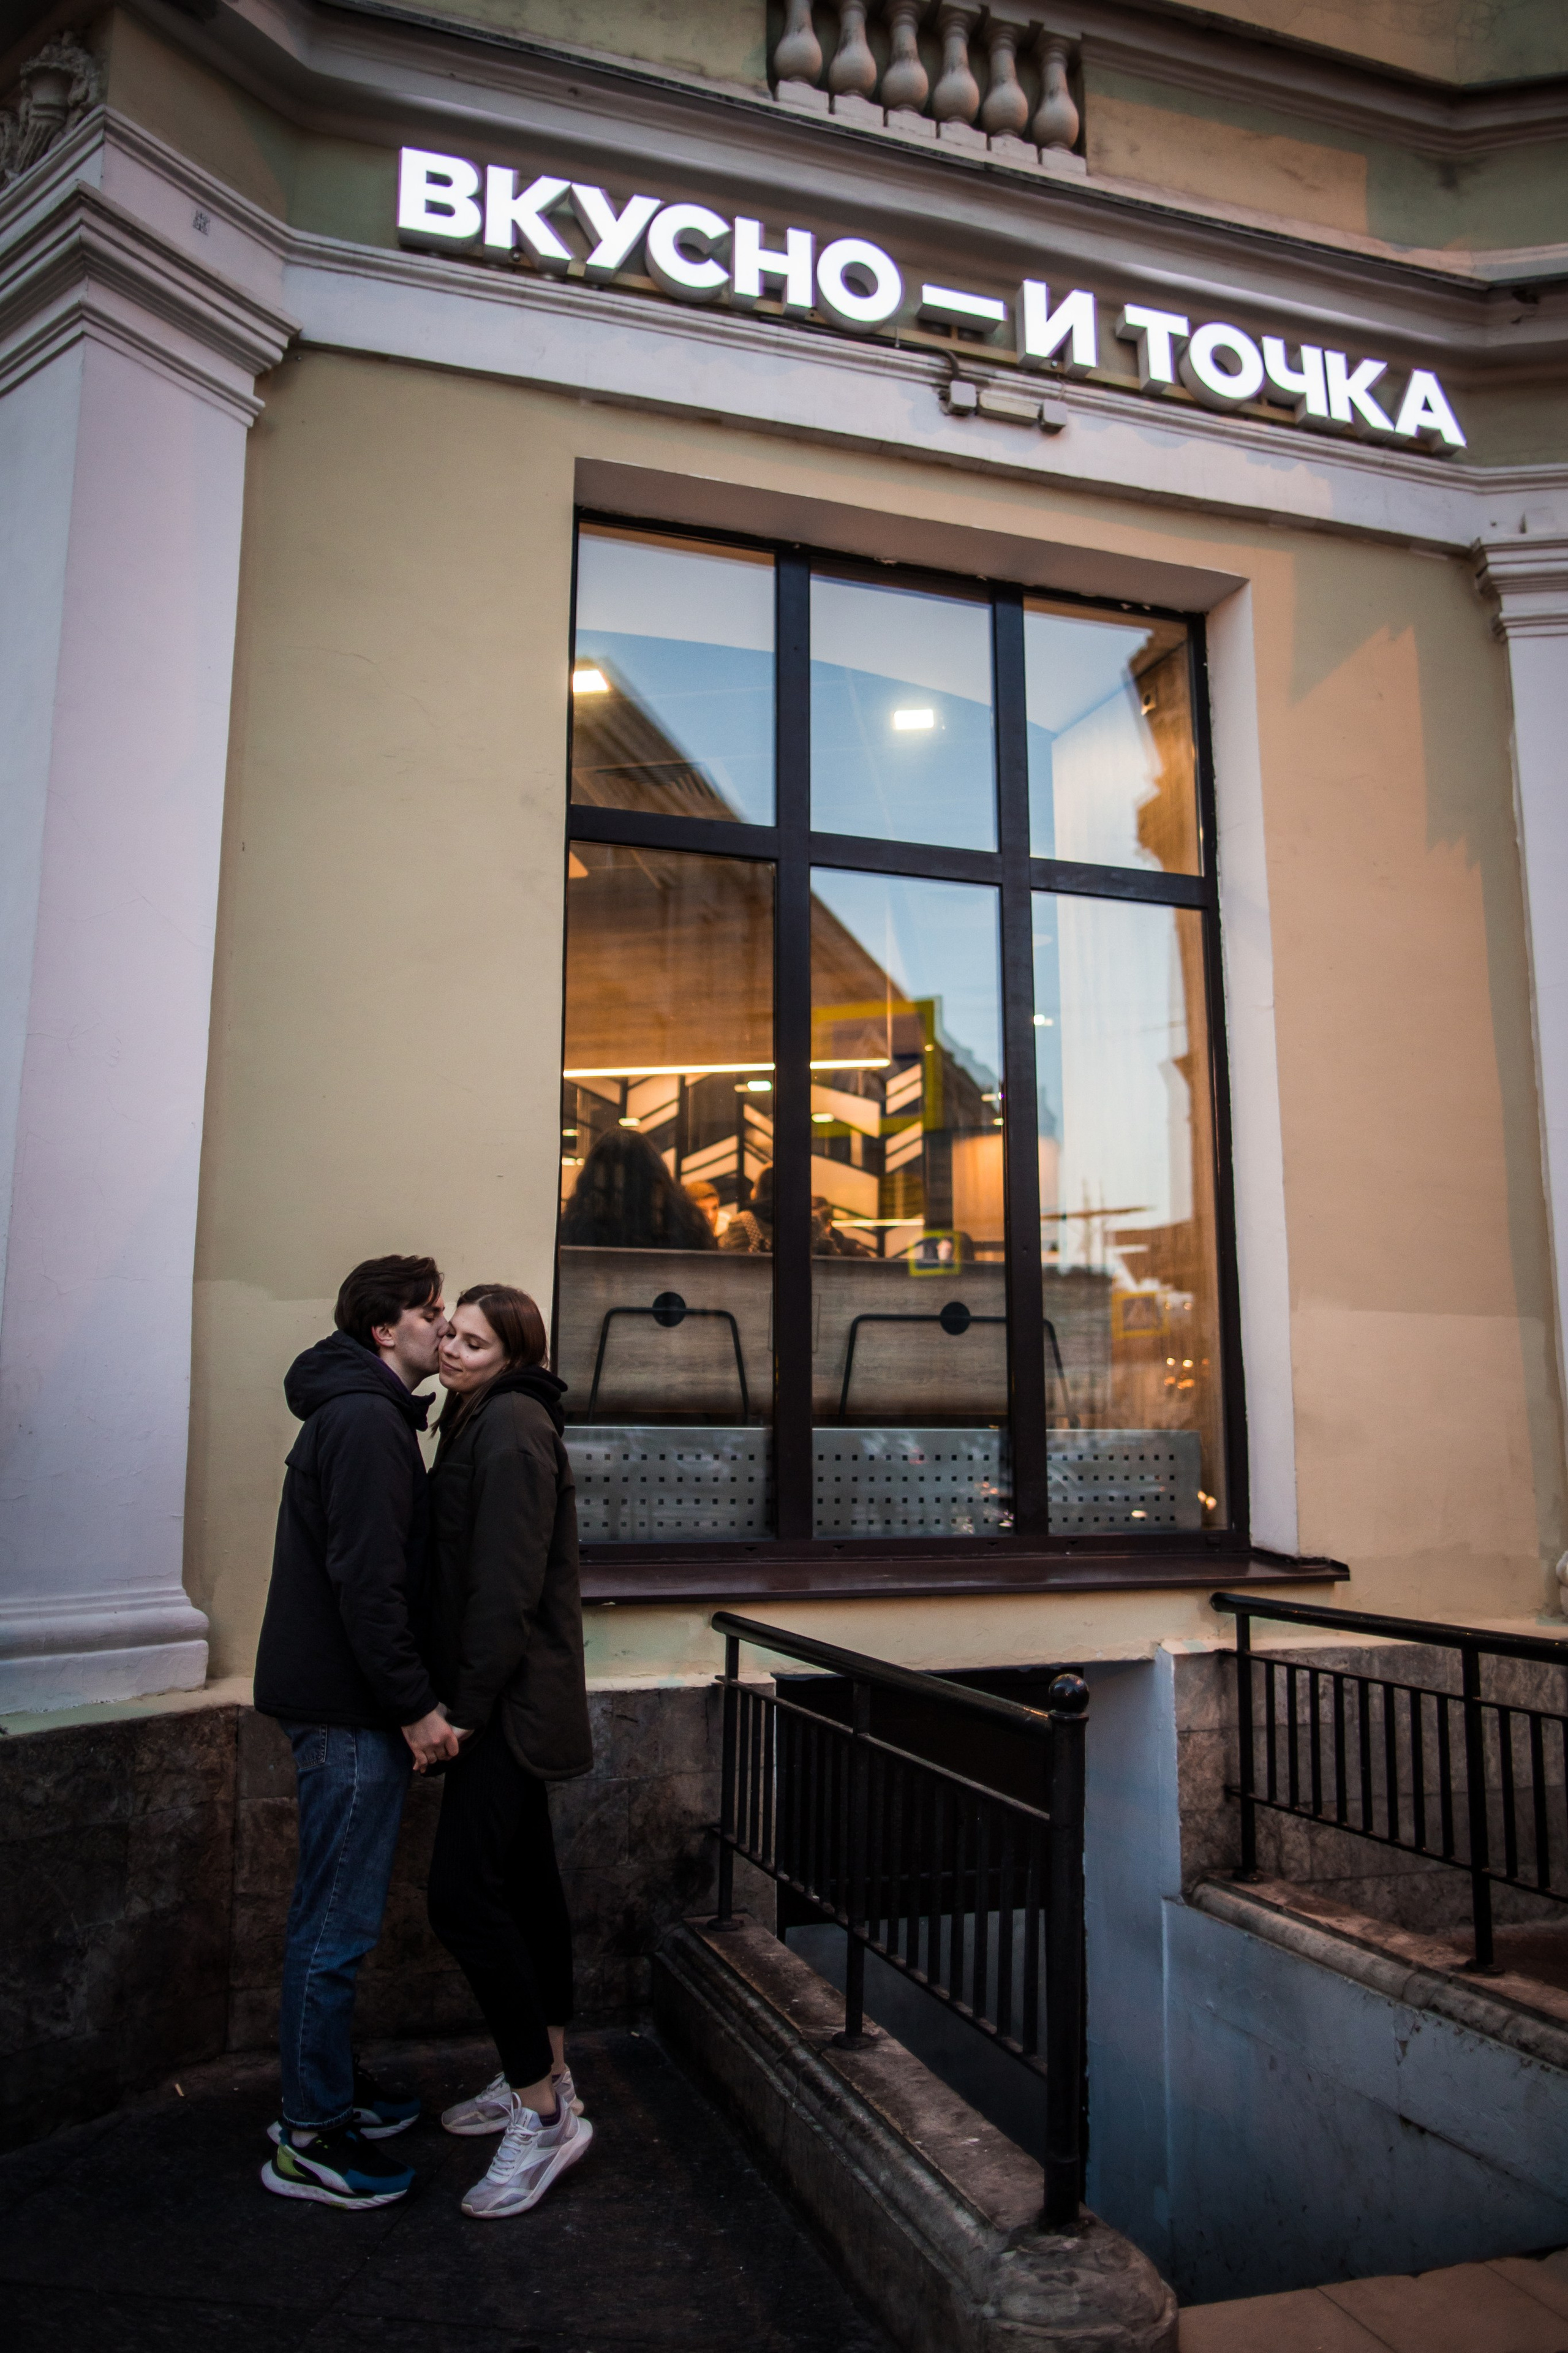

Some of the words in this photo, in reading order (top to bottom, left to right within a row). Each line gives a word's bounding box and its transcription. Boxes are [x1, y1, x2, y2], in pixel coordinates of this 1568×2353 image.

[398, 146, 903, 322] ВКУСНО
[1022, 279, 1098, 369] И
[1123, 304, 1467, 448] ТОЧКА
